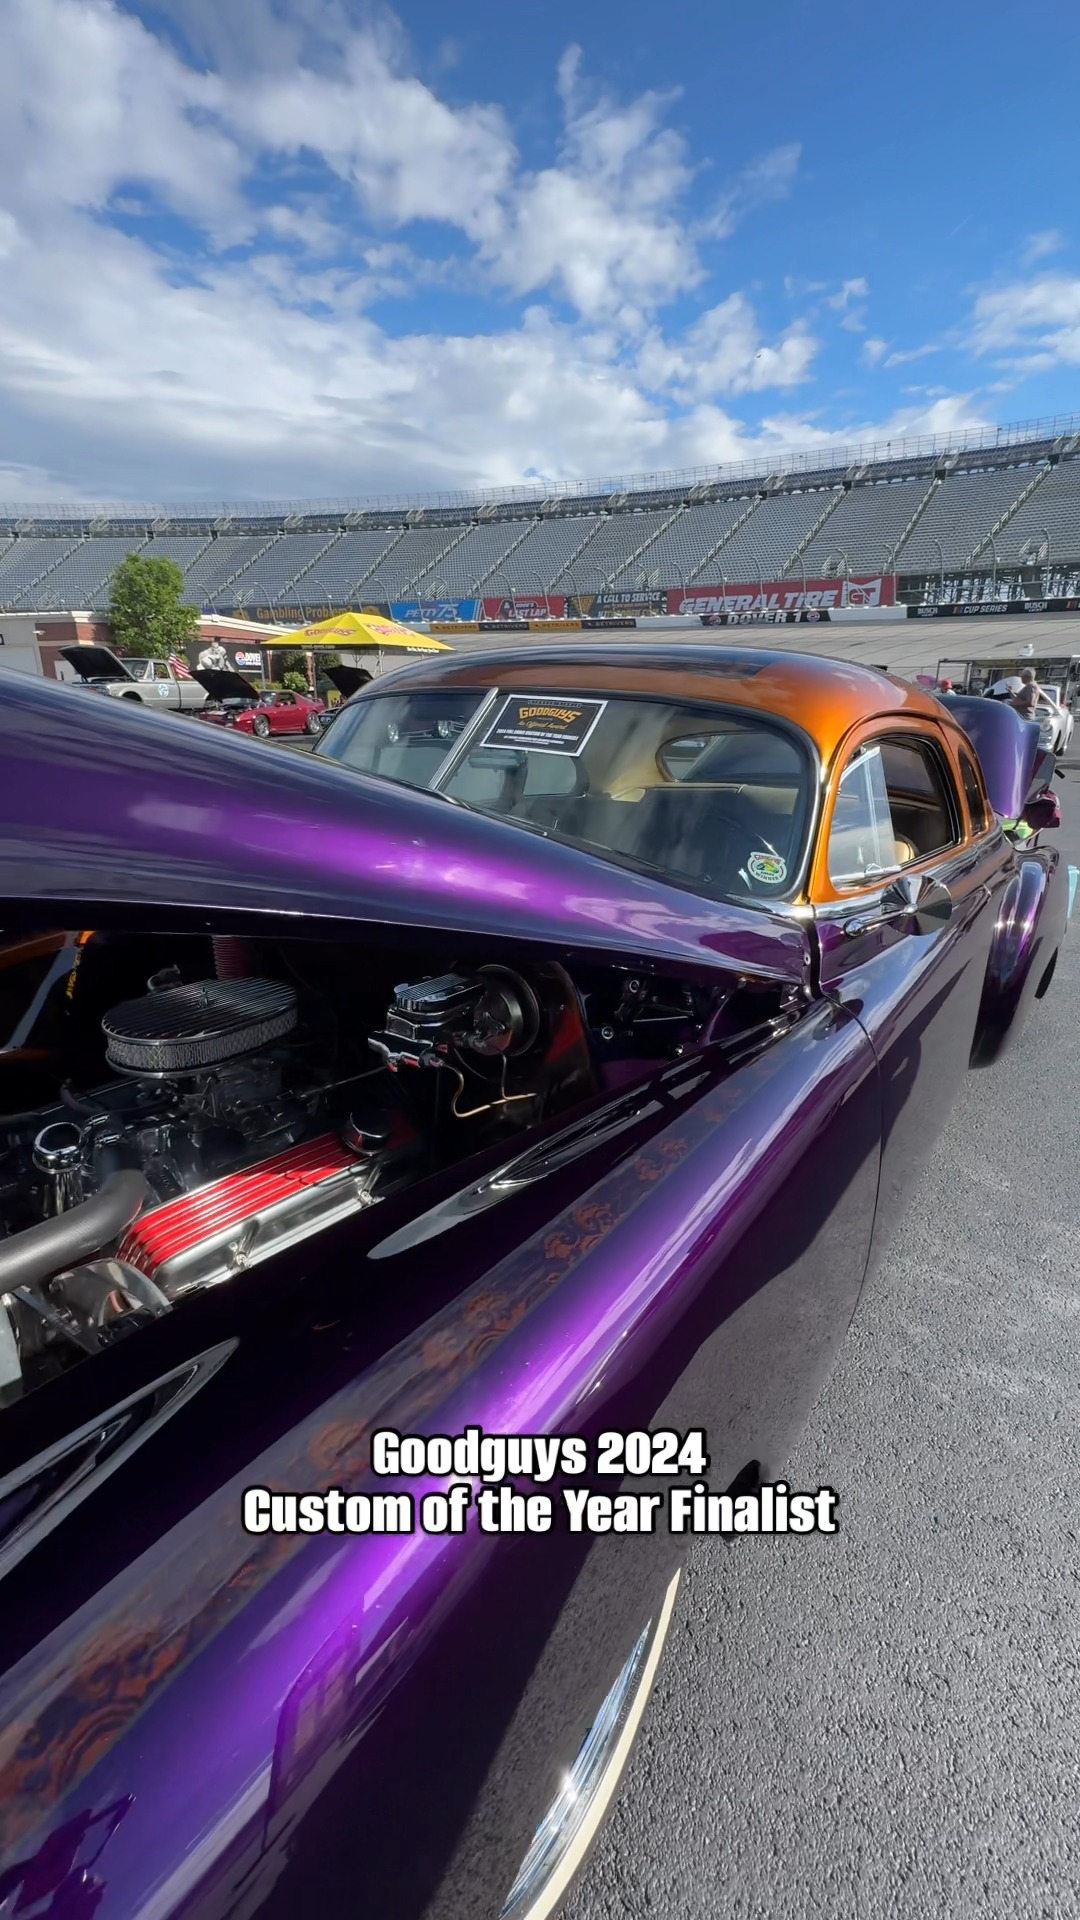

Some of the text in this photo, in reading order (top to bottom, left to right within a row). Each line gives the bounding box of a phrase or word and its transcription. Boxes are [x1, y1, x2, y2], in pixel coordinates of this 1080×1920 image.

[603, 594, 619, 604] CALL
[621, 593, 631, 602] TO
[631, 592, 661, 602] SERVICE
[679, 588, 839, 614] GENERAL TIRE
[405, 603, 459, 618] PETTY 75
[917, 607, 938, 615] BUSCH
[963, 604, 1008, 614] CUP SERIES
[1024, 602, 1048, 610] BUSCH
[256, 605, 353, 621] Gambling Probem?
[508, 608, 547, 618] LAST LAP
[727, 611, 802, 624] DOVER 1
[518, 706, 583, 724] GOODGUYS
